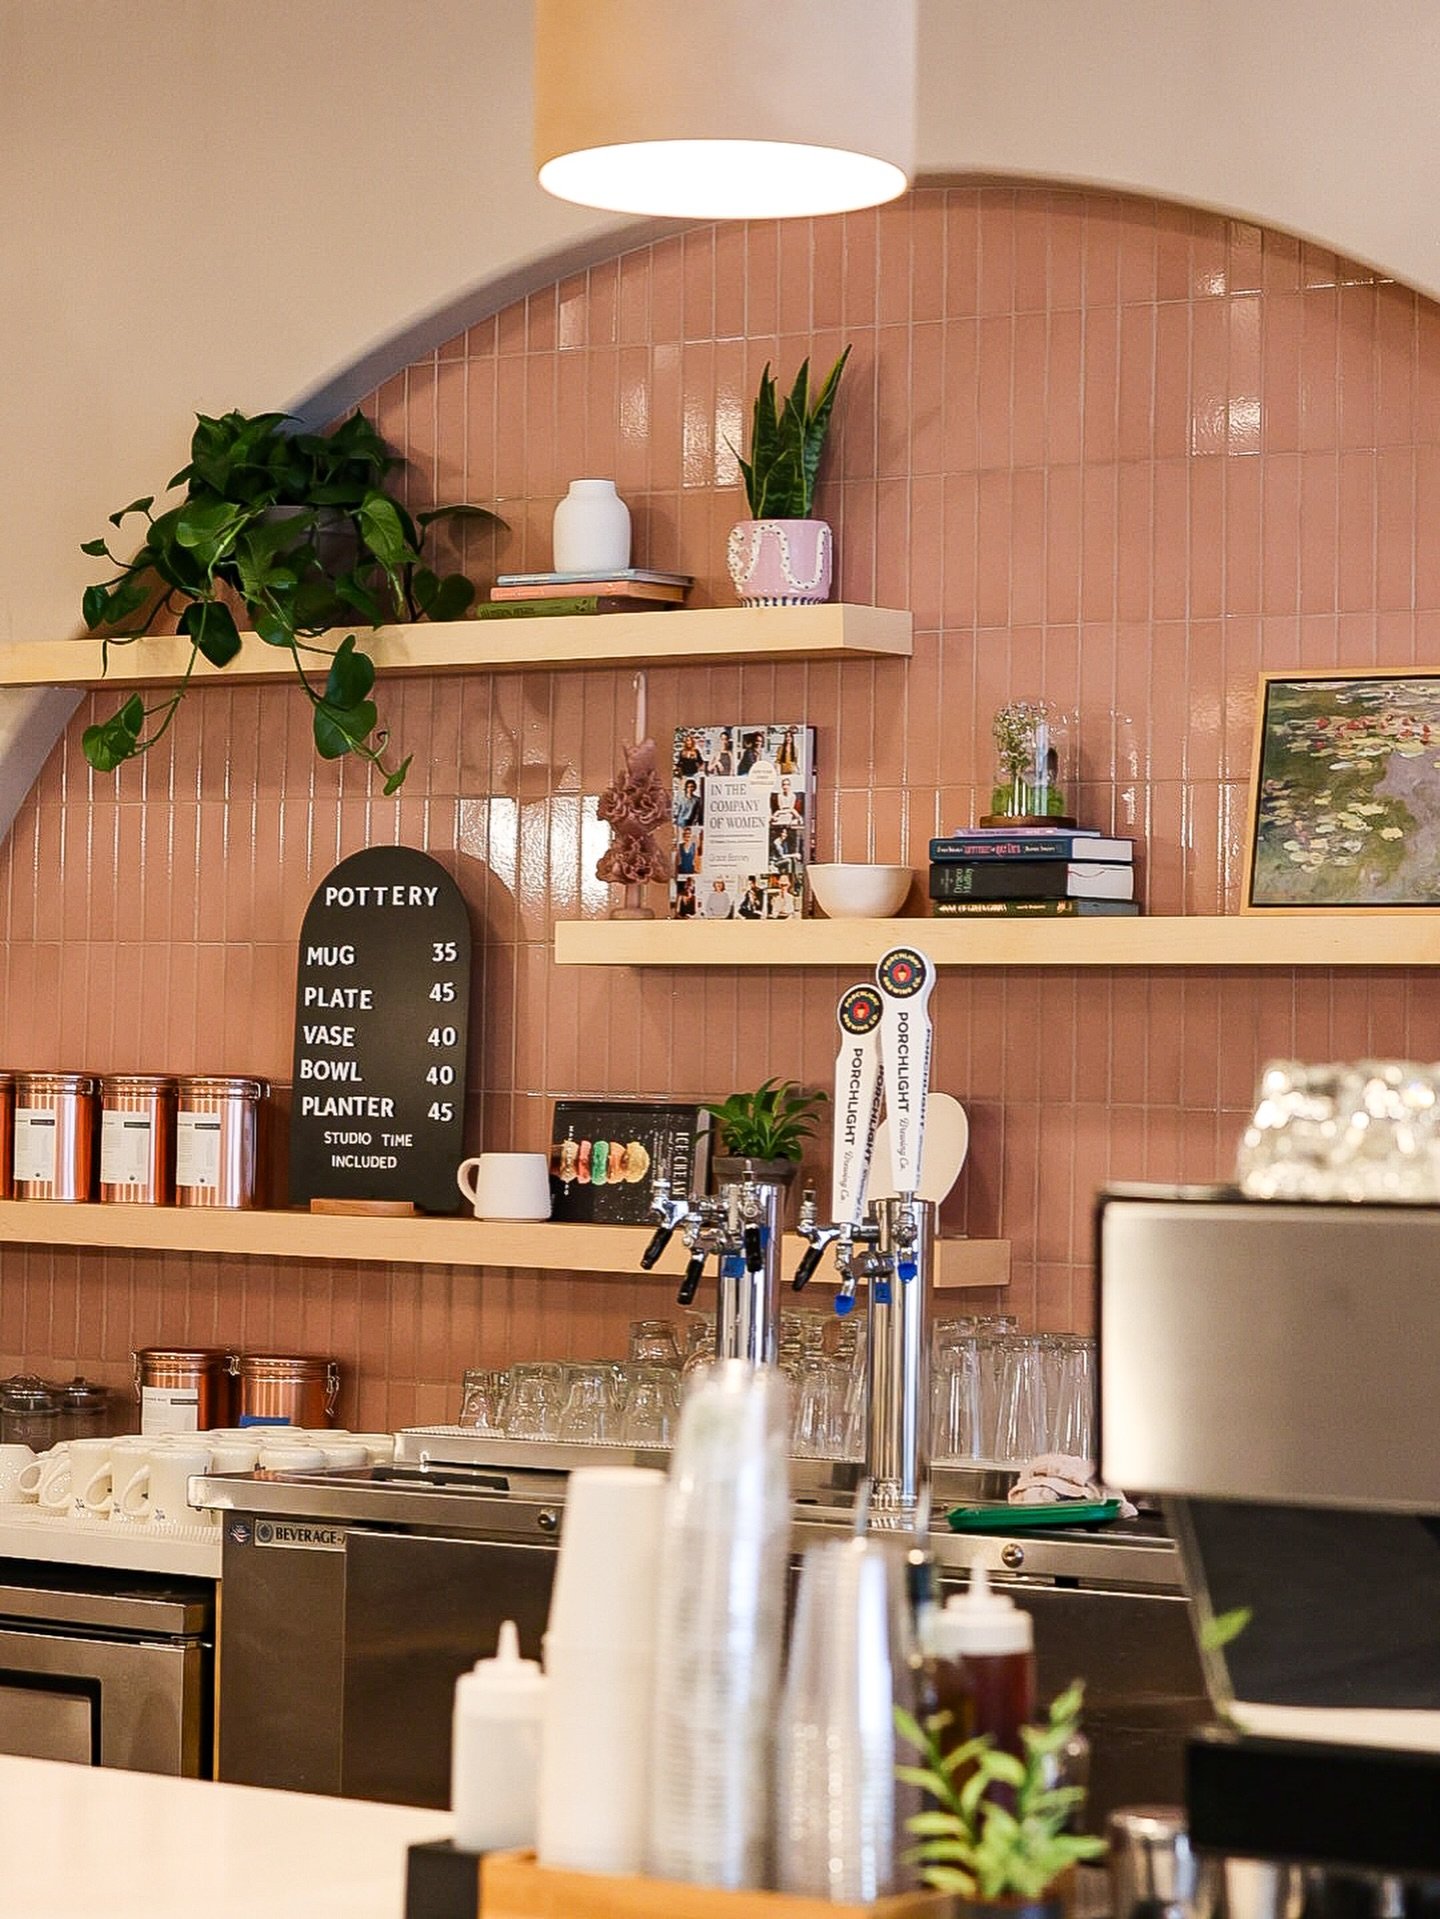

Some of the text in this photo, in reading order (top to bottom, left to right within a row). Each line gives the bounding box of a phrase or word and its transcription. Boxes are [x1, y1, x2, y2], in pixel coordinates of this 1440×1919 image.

[710, 783, 747, 796] IN THE
[709, 800, 760, 813] COMPANY
[709, 816, 766, 829] OF WOMEN
[325, 886, 438, 907] POTTERY
[306, 942, 457, 966] MUG 35
[304, 981, 455, 1010] PLATE 45
[303, 1025, 456, 1047] VASE 40
[299, 1059, 453, 1086] BOWL 40
[897, 1012, 909, 1112] PORCHLIGHT
[844, 1048, 863, 1145] PORCHLIGHT
[302, 1096, 453, 1122] PLANTER 45
[323, 1131, 413, 1147] STUDIO TIME
[331, 1154, 398, 1169] INCLUDED
